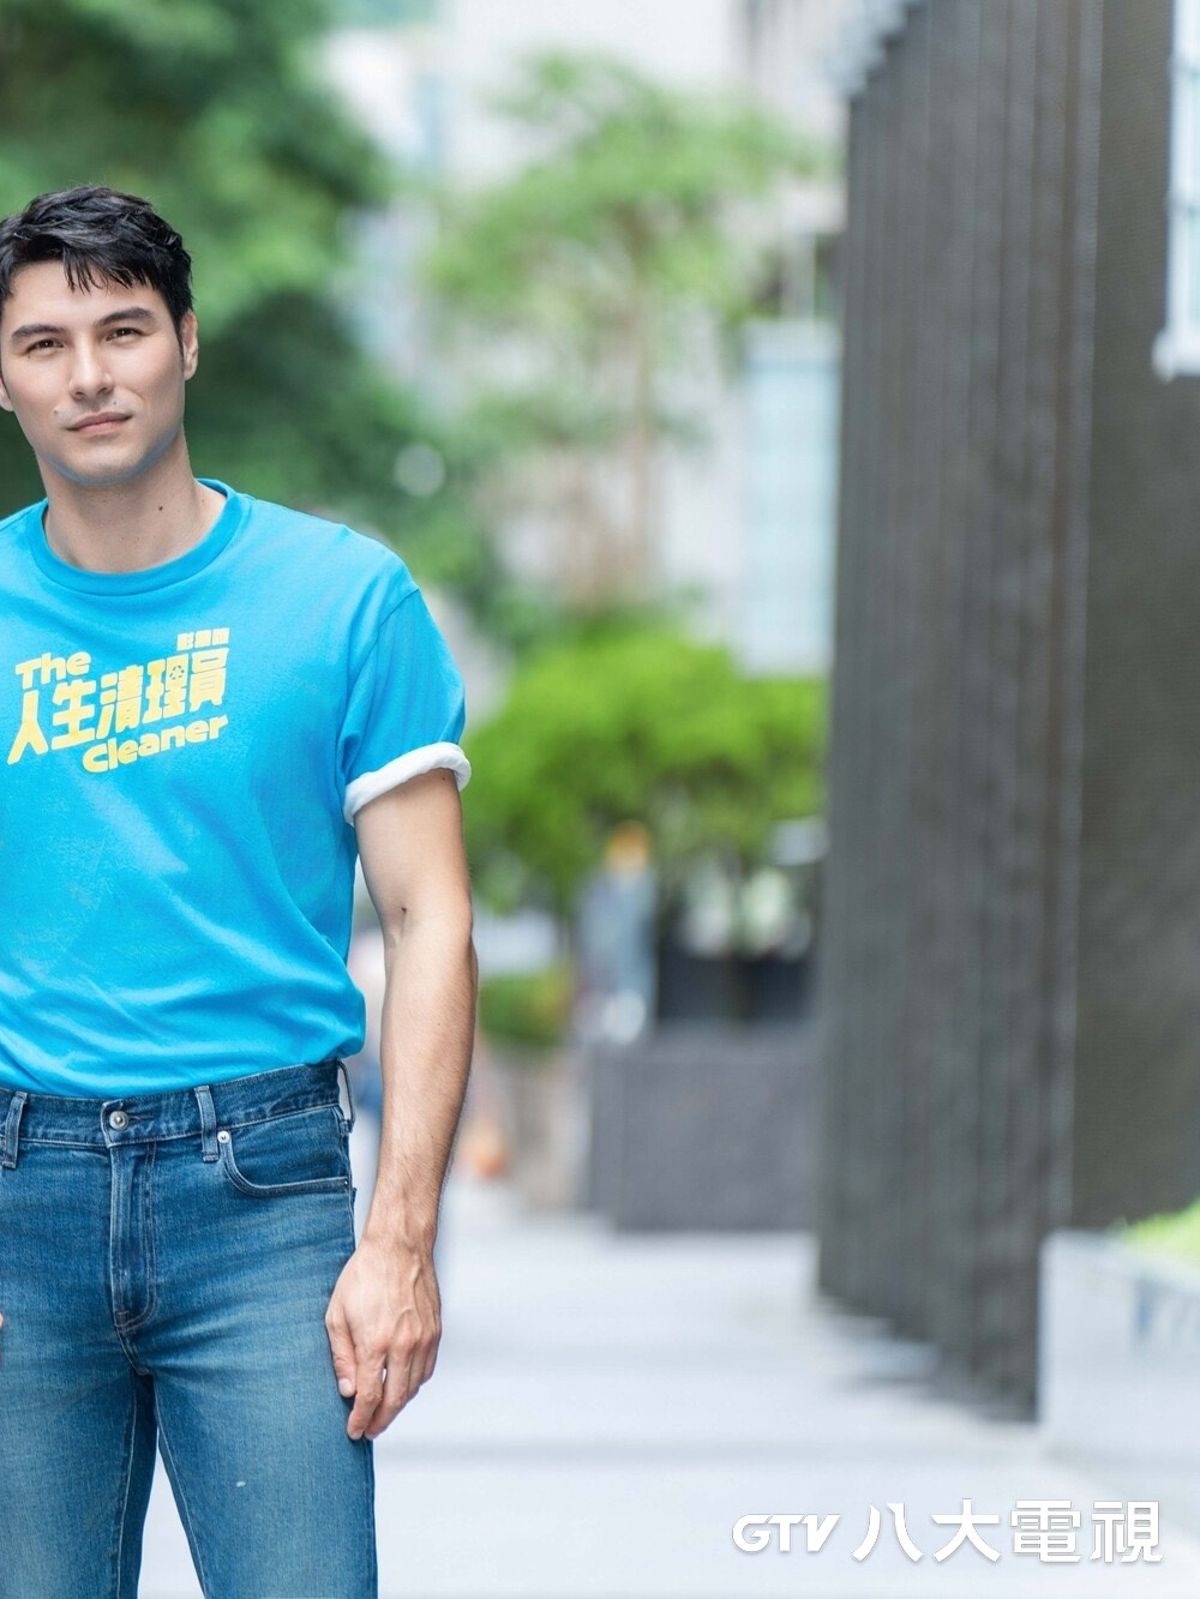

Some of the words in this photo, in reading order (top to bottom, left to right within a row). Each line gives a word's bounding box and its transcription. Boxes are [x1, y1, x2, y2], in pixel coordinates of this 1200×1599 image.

[15, 651, 92, 690] The
[6, 647, 230, 766] 人生清理員
[82, 714, 229, 773] Cleaner
